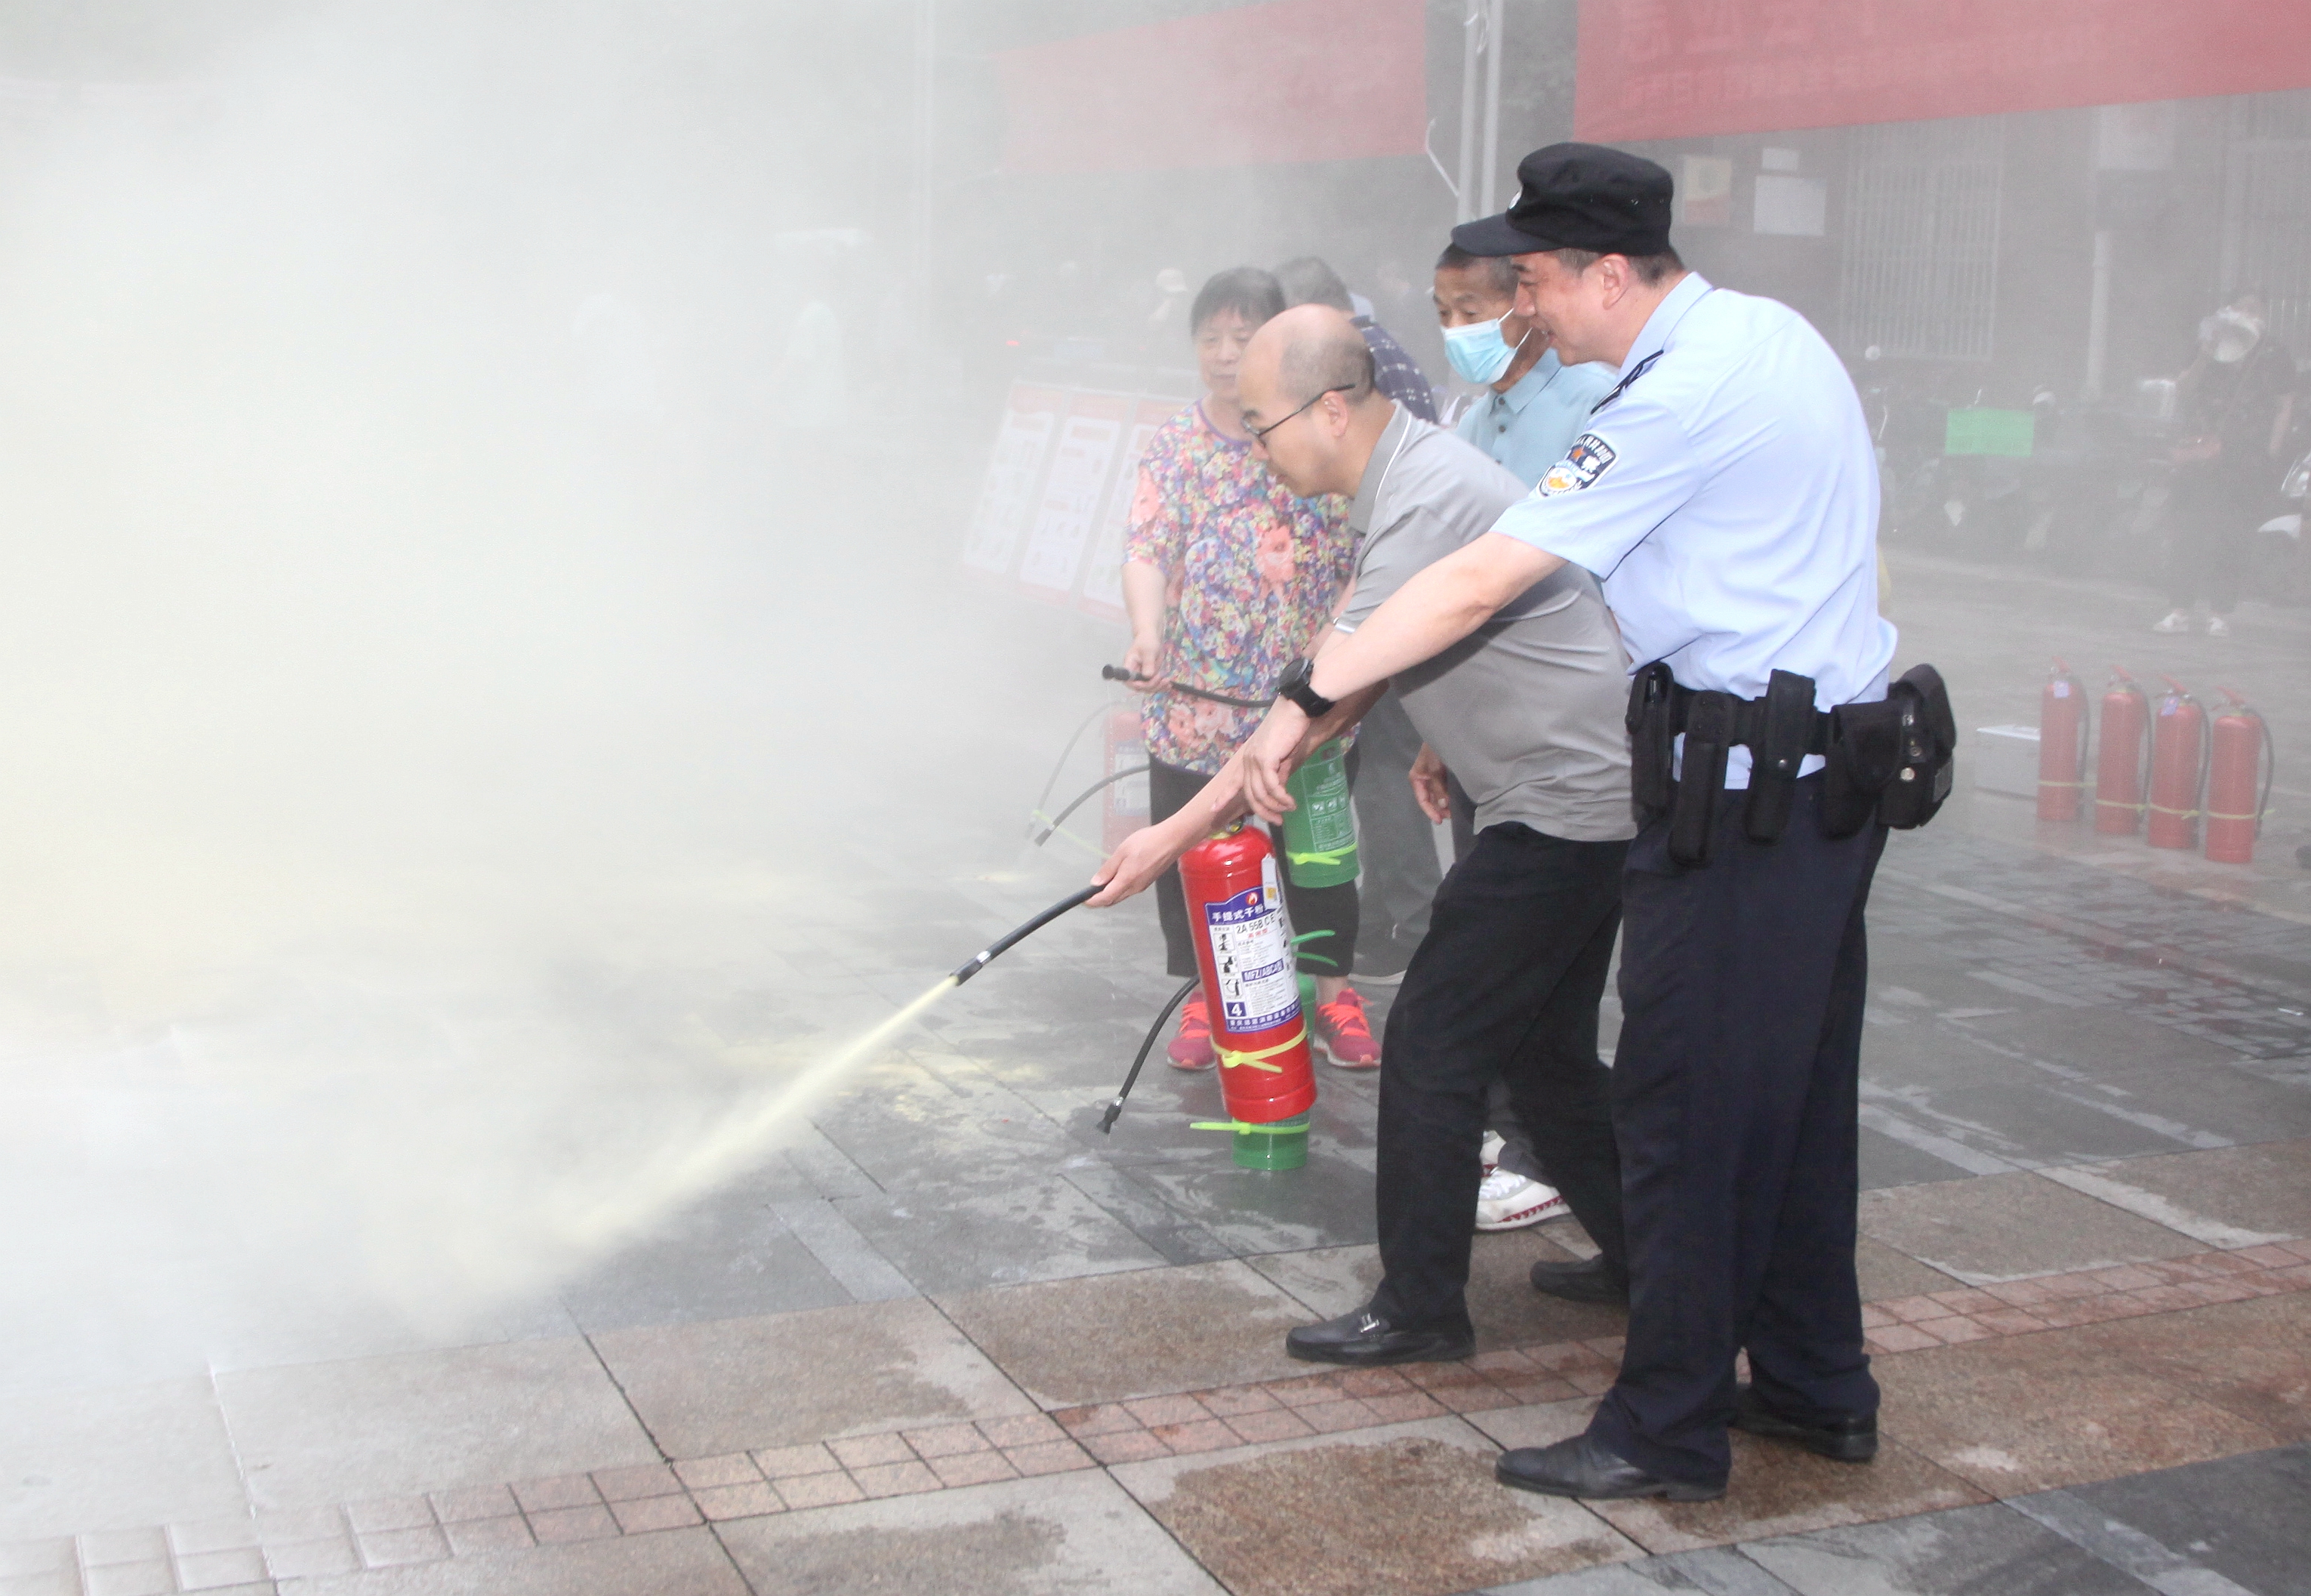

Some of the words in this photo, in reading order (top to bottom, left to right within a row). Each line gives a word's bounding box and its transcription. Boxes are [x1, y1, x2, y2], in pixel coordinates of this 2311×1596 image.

[1212, 904, 1267, 923] 手提式干粉
[1231, 1003, 1243, 1017] 4
